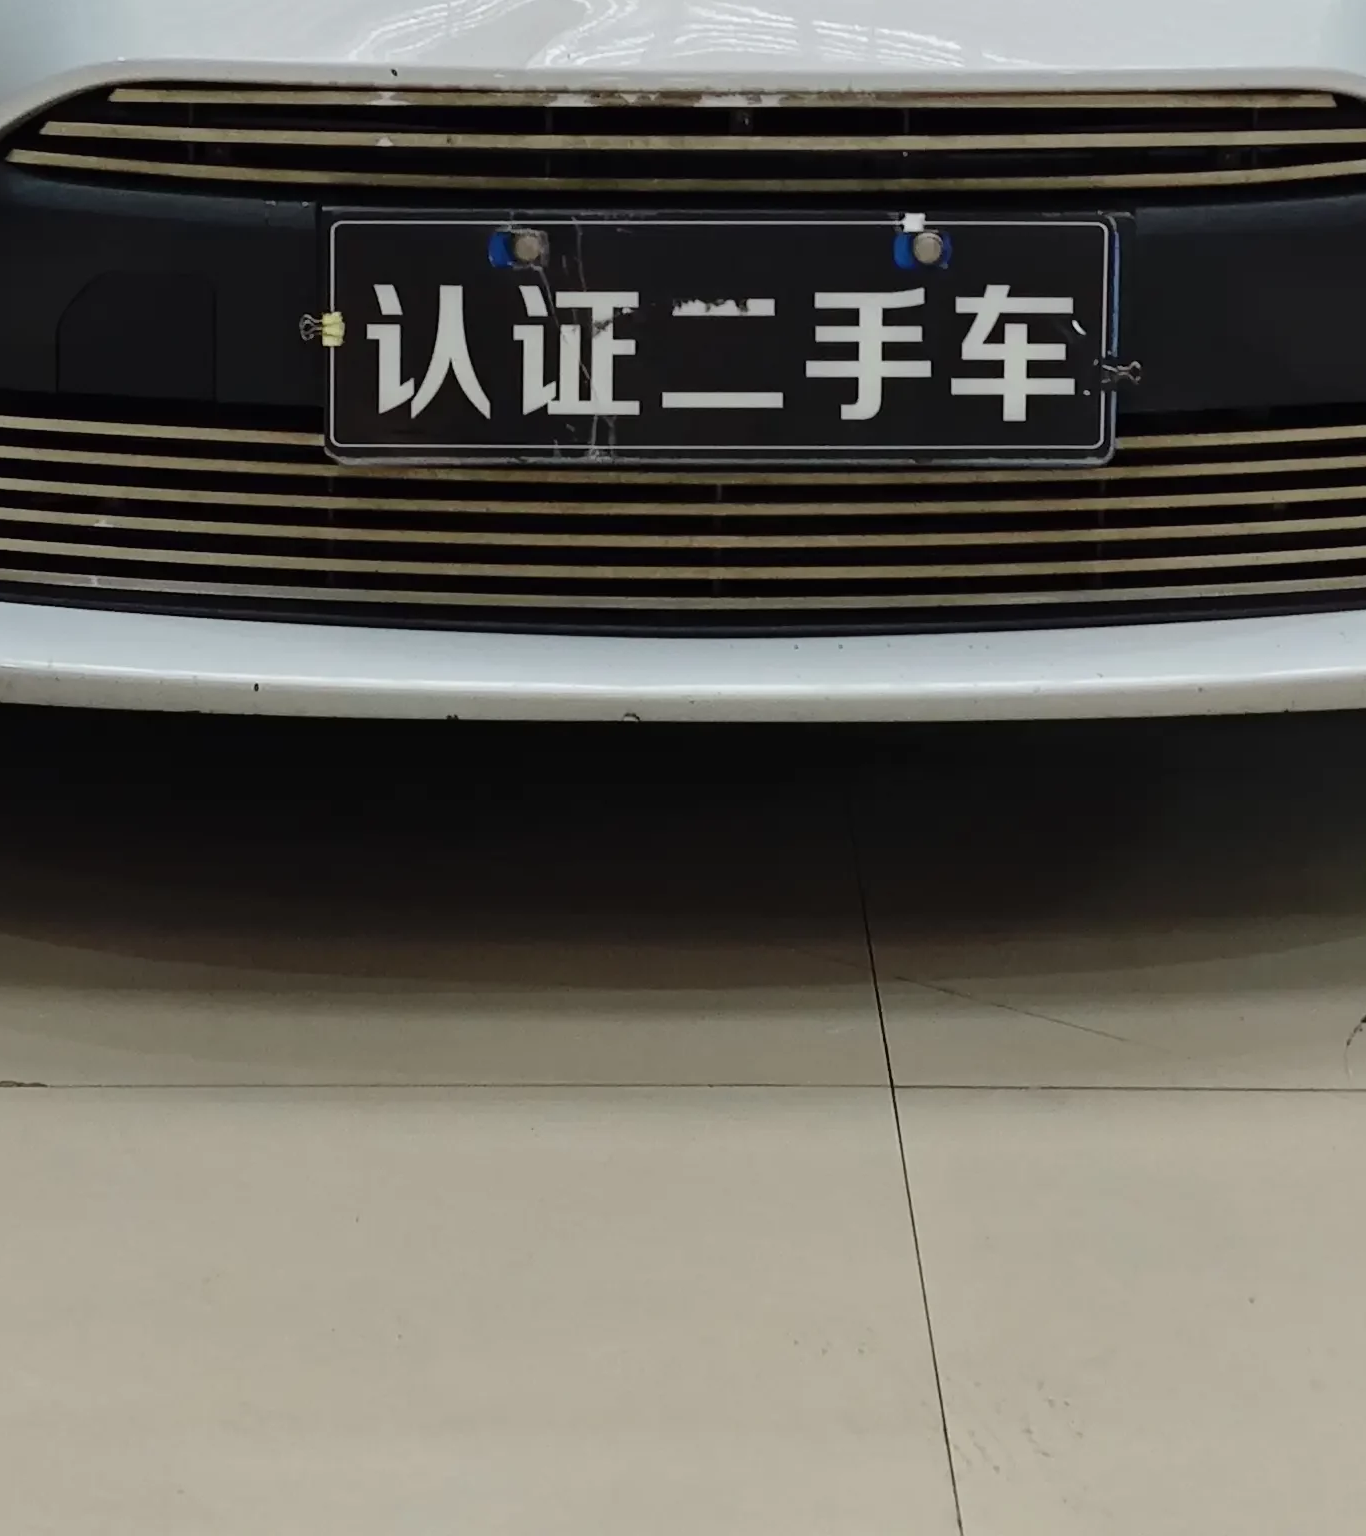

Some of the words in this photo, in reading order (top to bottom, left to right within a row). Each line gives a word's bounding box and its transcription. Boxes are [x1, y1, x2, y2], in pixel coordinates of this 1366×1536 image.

[366, 284, 1077, 422] 认证二手车
